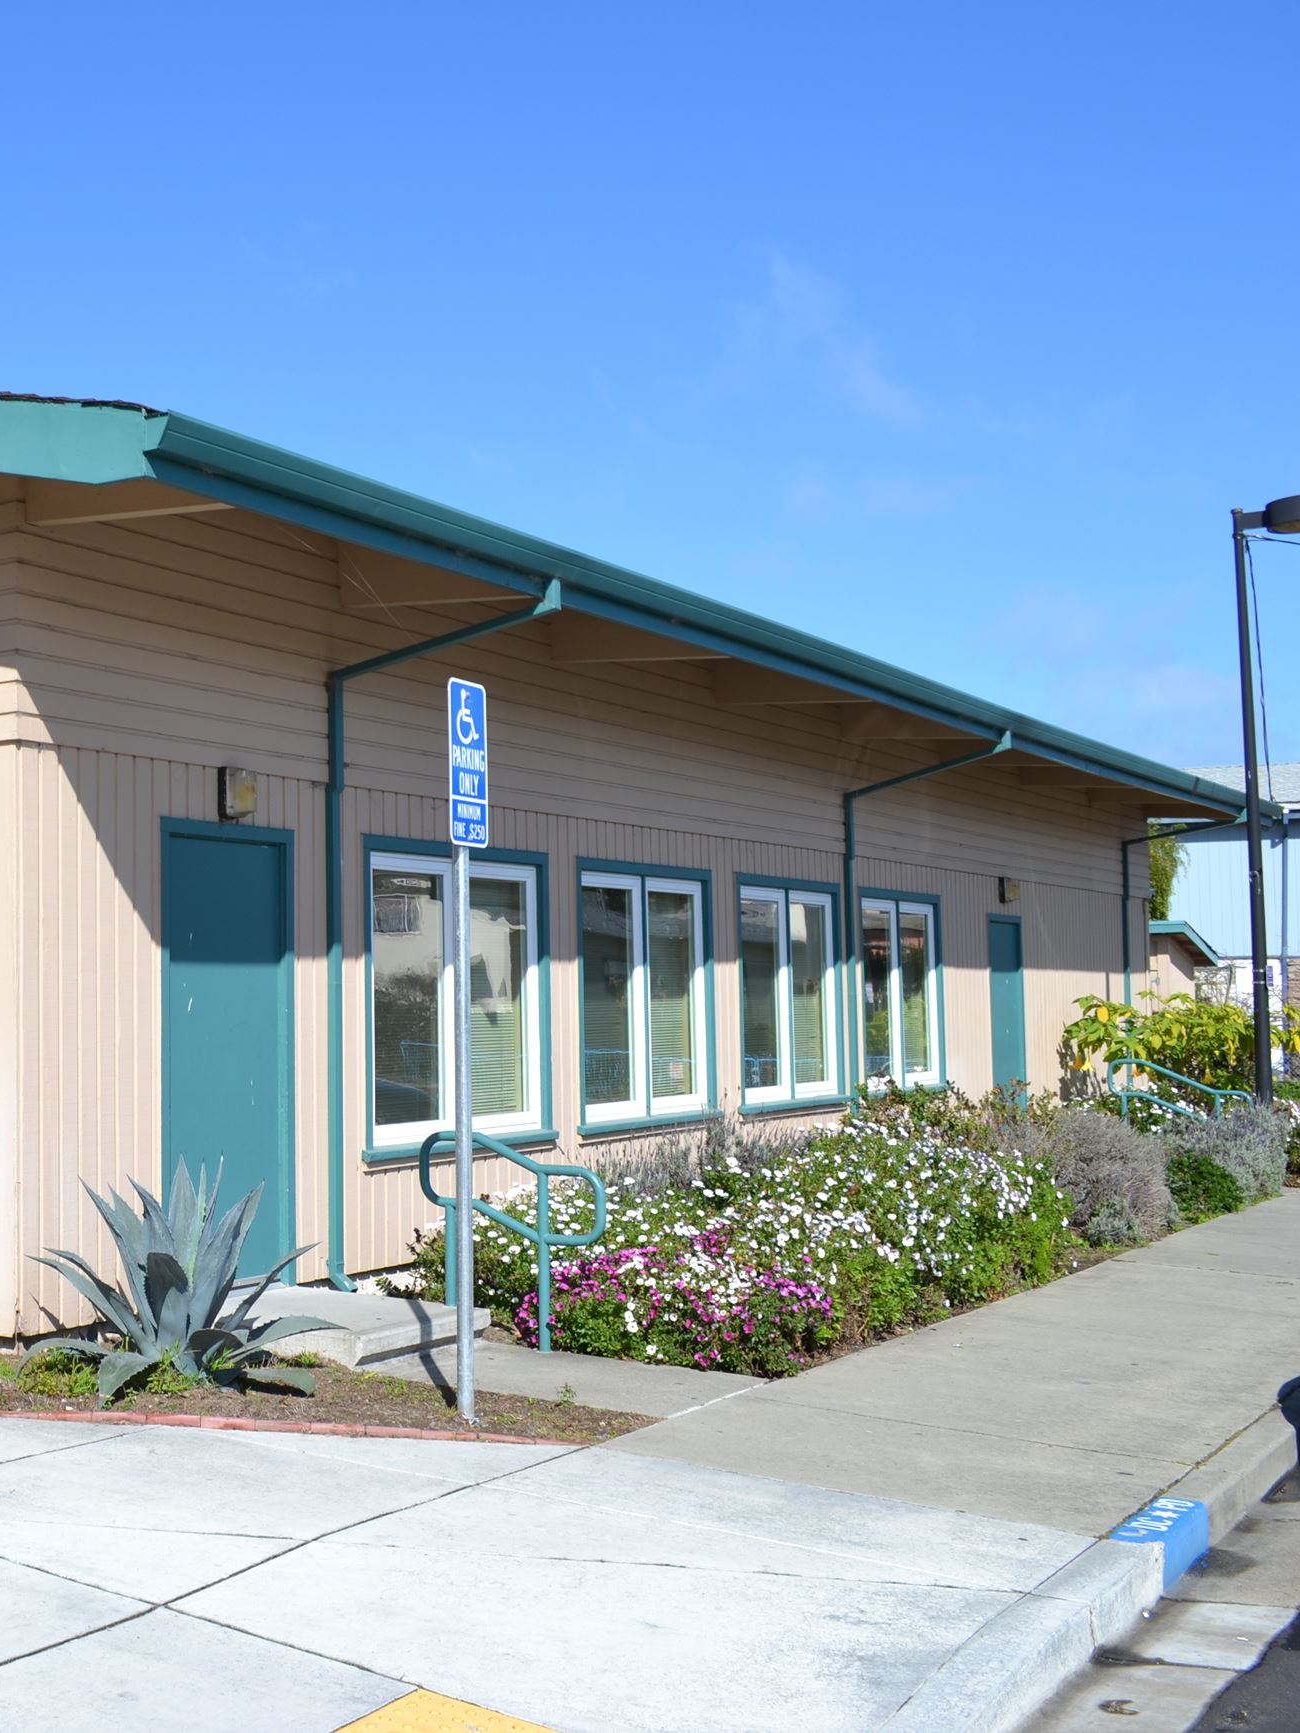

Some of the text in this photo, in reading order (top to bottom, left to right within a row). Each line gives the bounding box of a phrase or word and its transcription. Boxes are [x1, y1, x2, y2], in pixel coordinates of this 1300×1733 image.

[452, 744, 485, 772] PARKING
[459, 771, 480, 797] ONLY
[457, 802, 482, 821] MINIMUM
[453, 821, 486, 841] FINE $250
